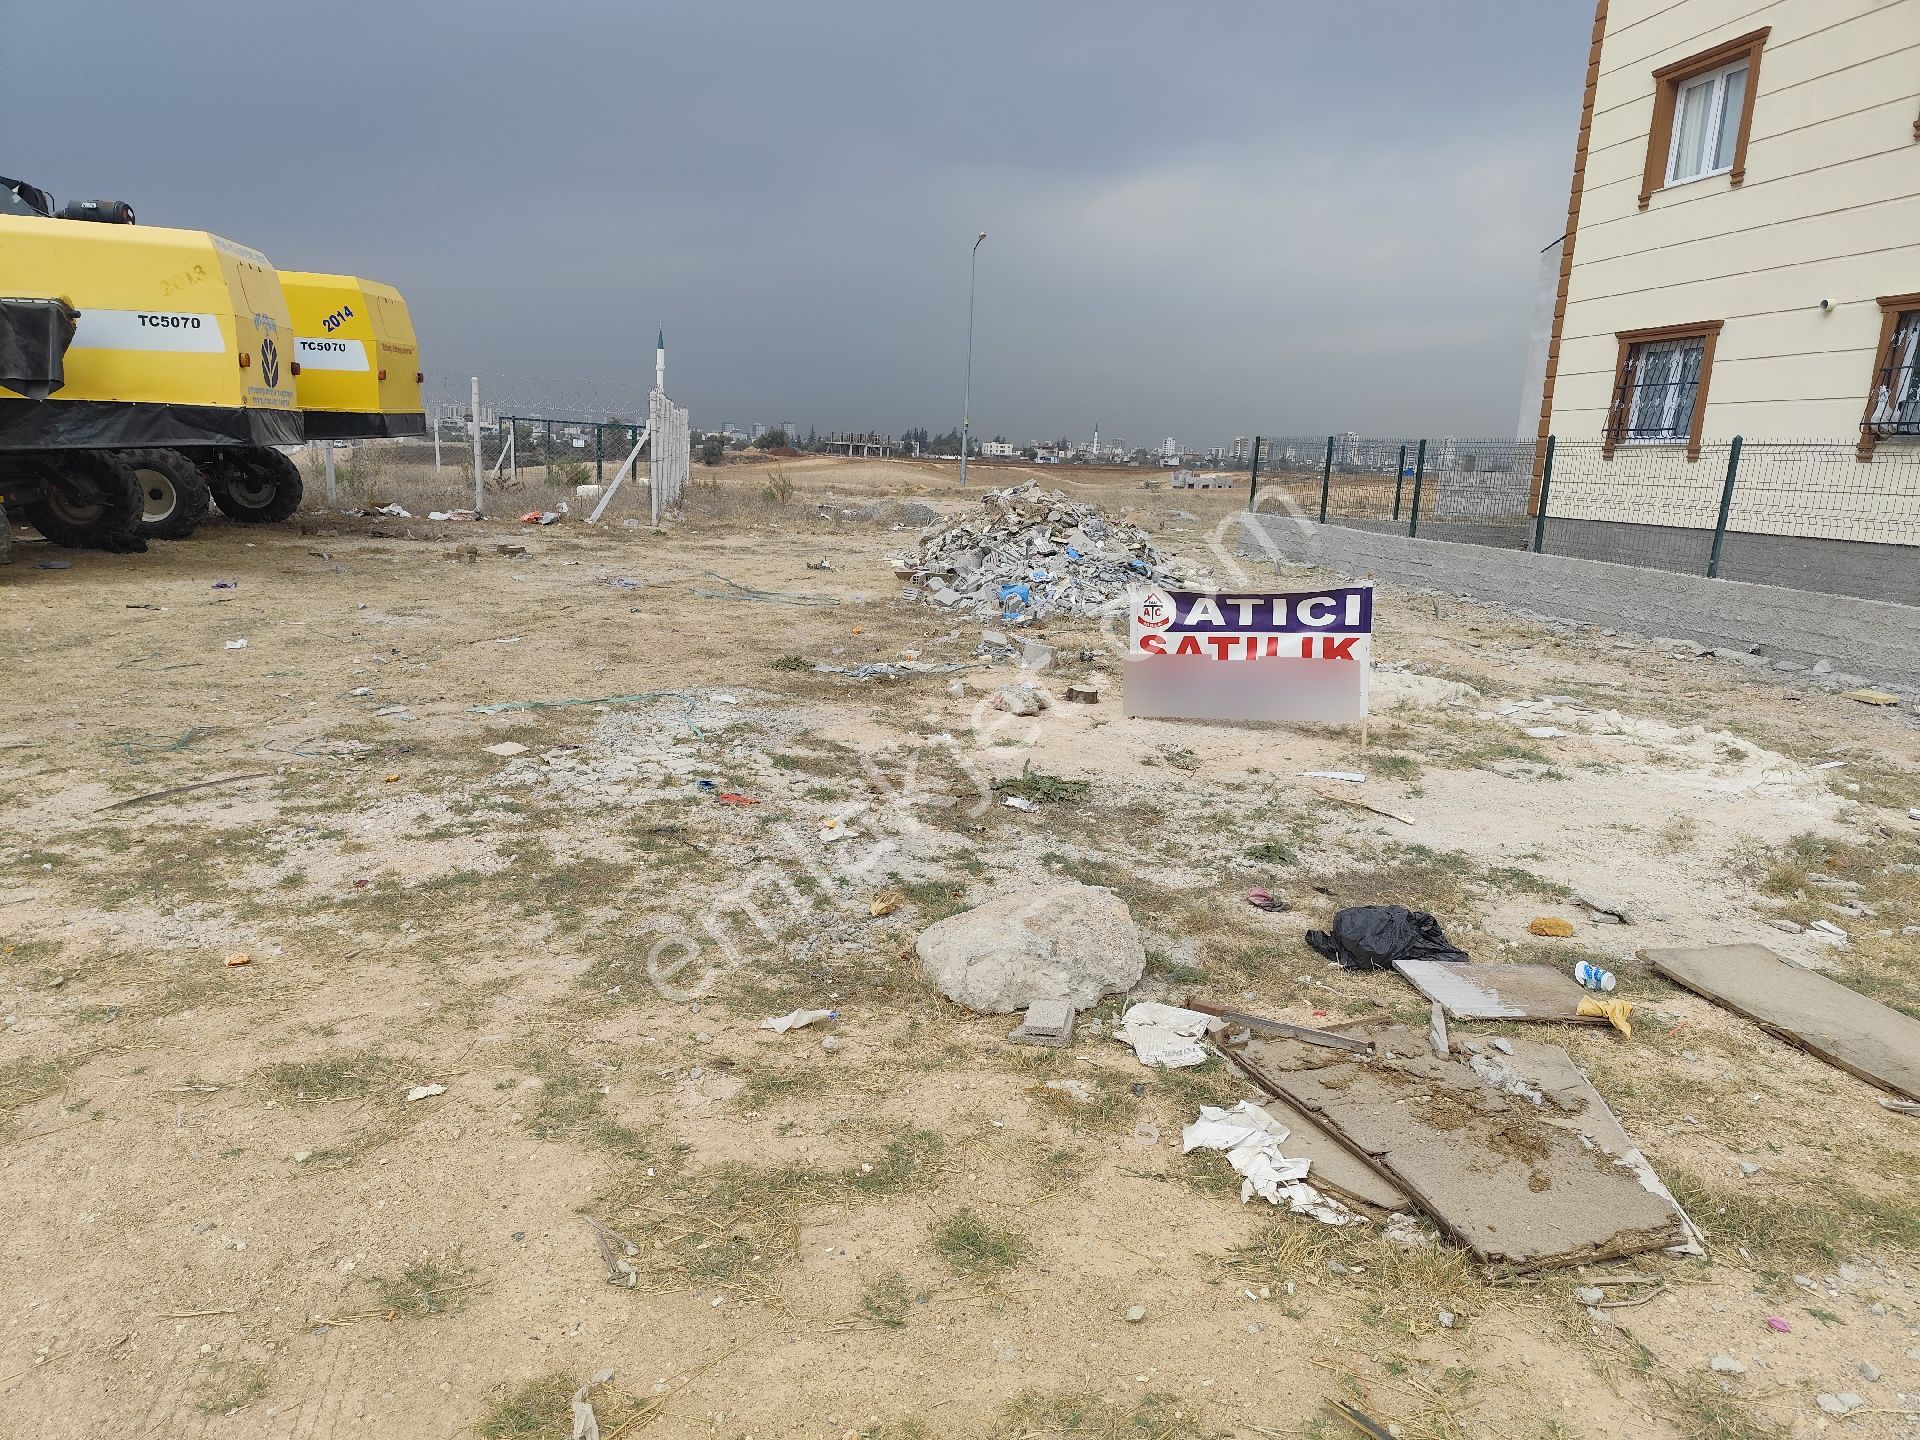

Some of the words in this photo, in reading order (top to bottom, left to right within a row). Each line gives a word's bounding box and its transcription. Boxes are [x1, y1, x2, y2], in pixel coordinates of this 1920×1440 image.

[138, 314, 200, 329] TC5070
[322, 305, 354, 333] 2014
[300, 341, 346, 352] TC5070
[1183, 594, 1361, 627] ATICI
